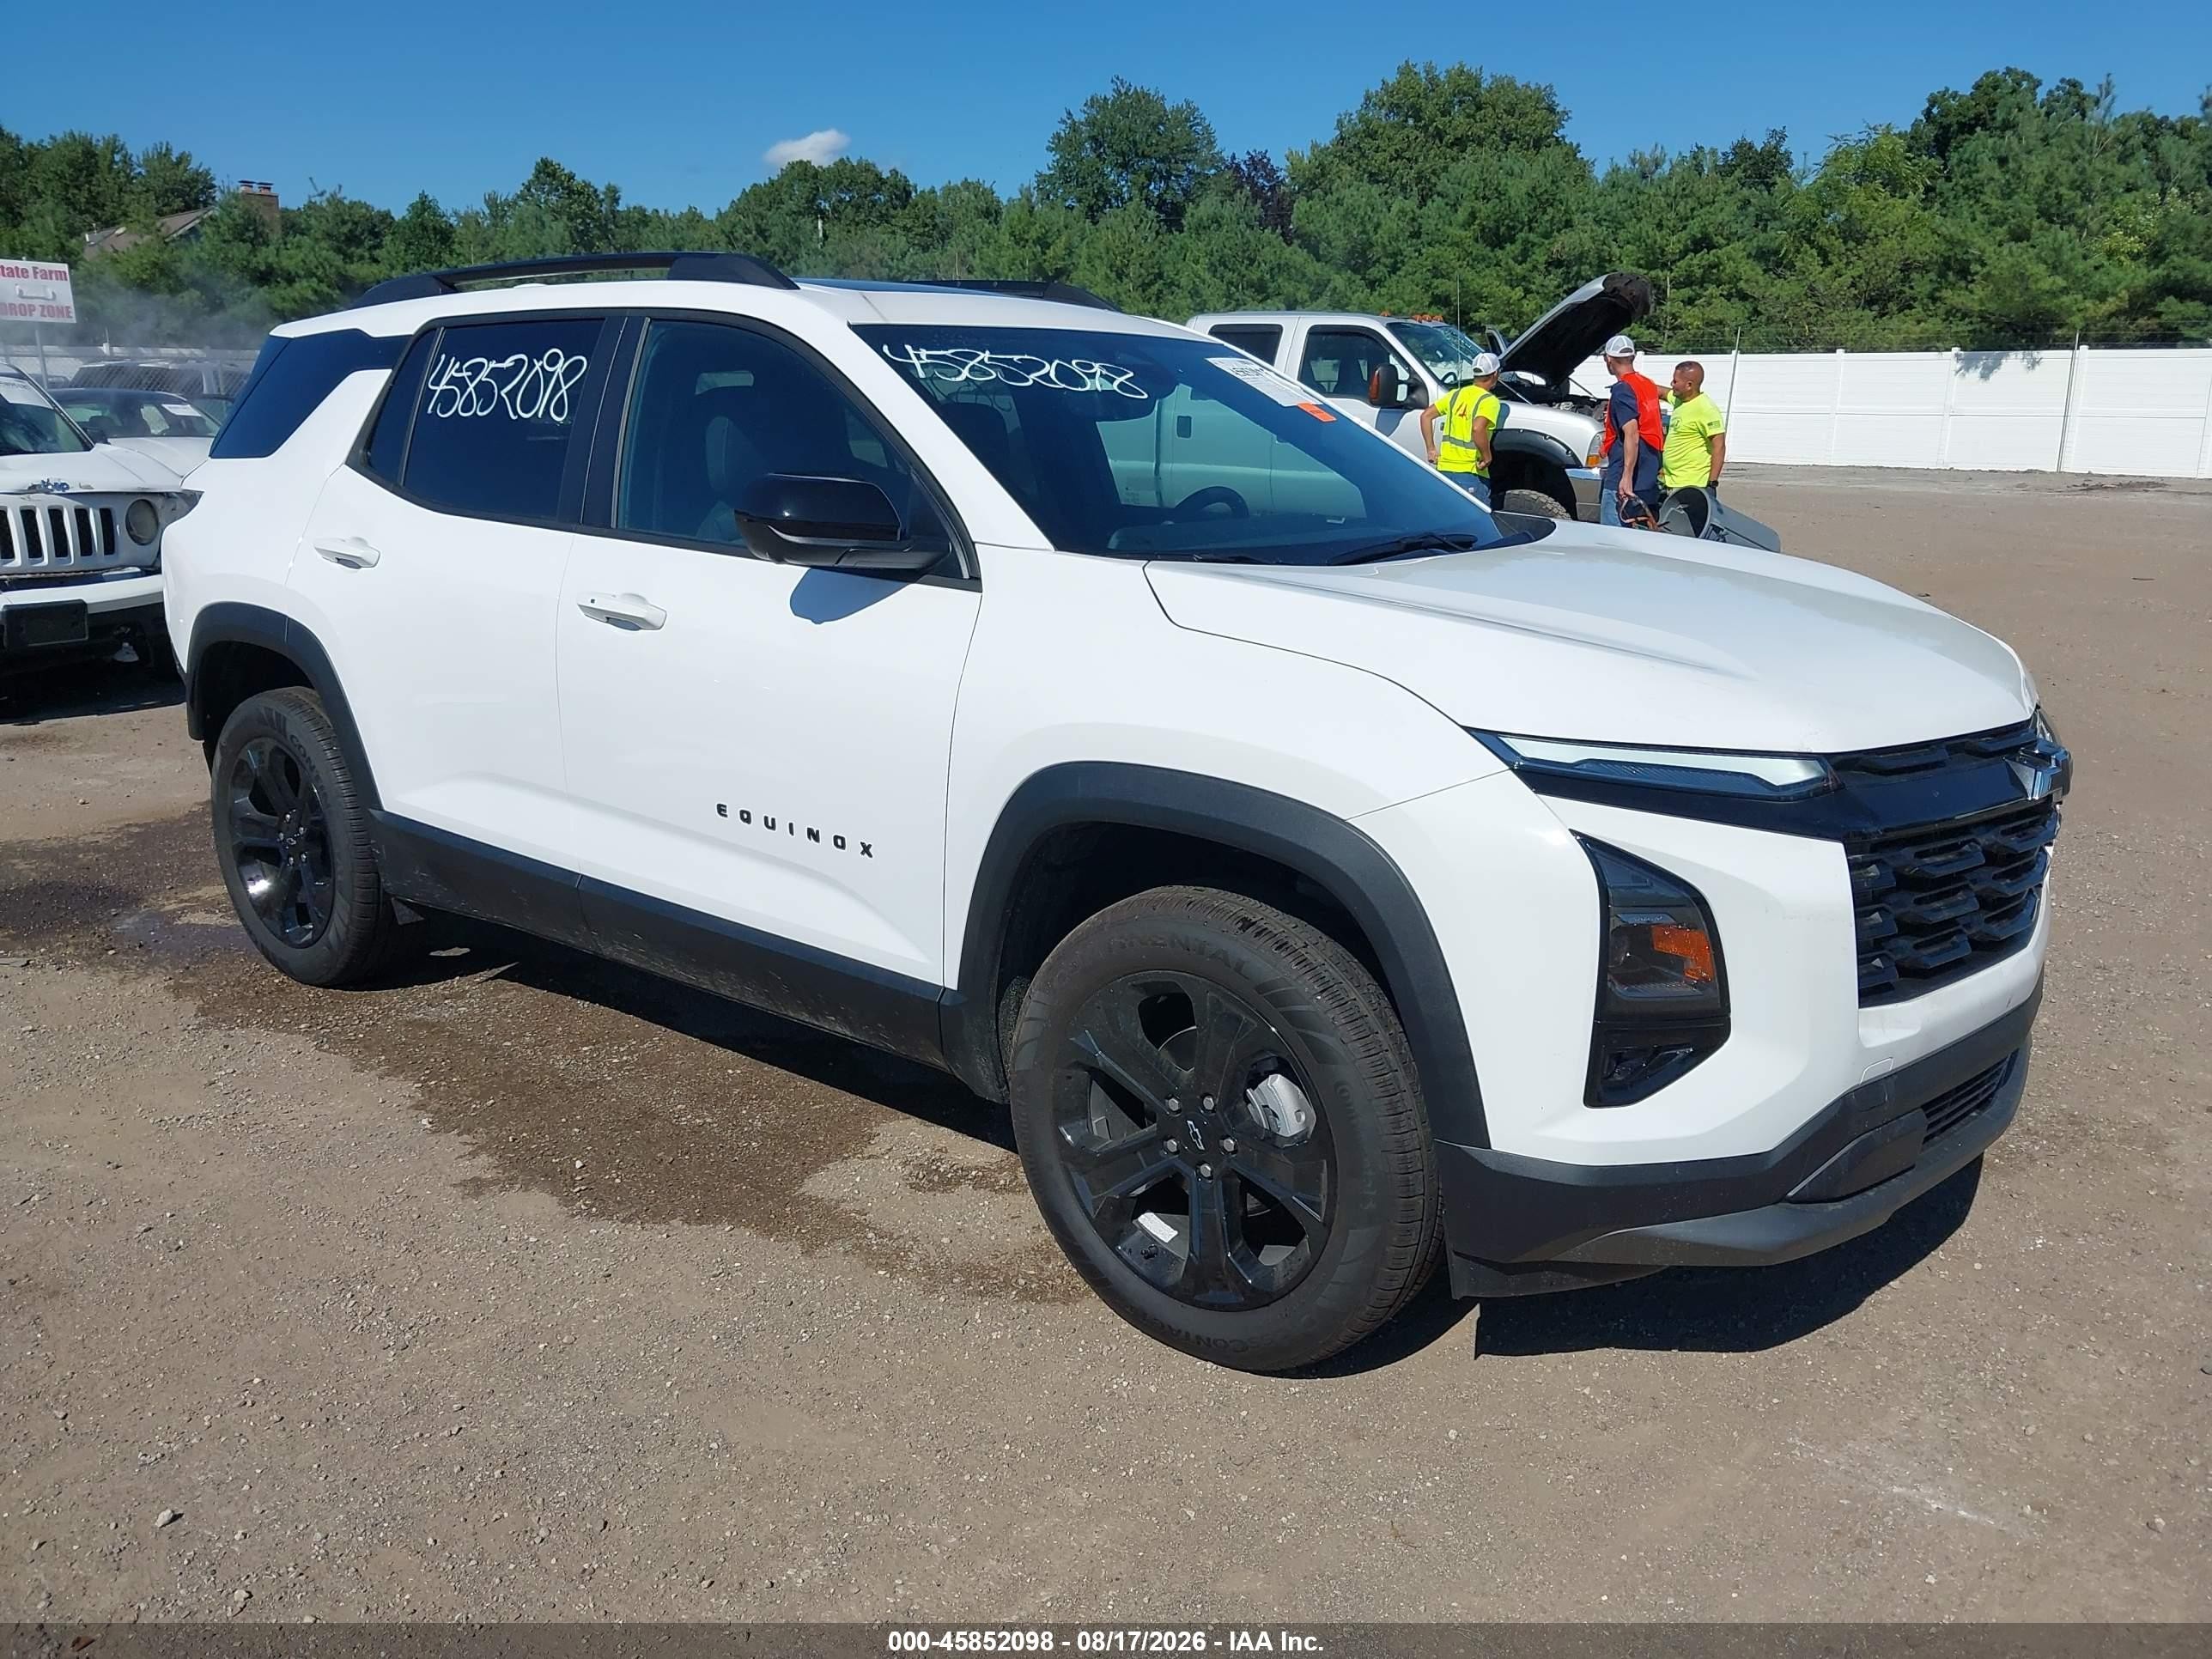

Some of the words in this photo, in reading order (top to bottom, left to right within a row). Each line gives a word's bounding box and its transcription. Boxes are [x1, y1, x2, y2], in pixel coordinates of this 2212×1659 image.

[0, 264, 29, 279] tate
[32, 266, 68, 282] Farm
[39, 304, 73, 319] ZONE
[427, 348, 587, 422] 45852098
[883, 343, 1148, 399] 45852098
[716, 803, 873, 859] EQUINOX
